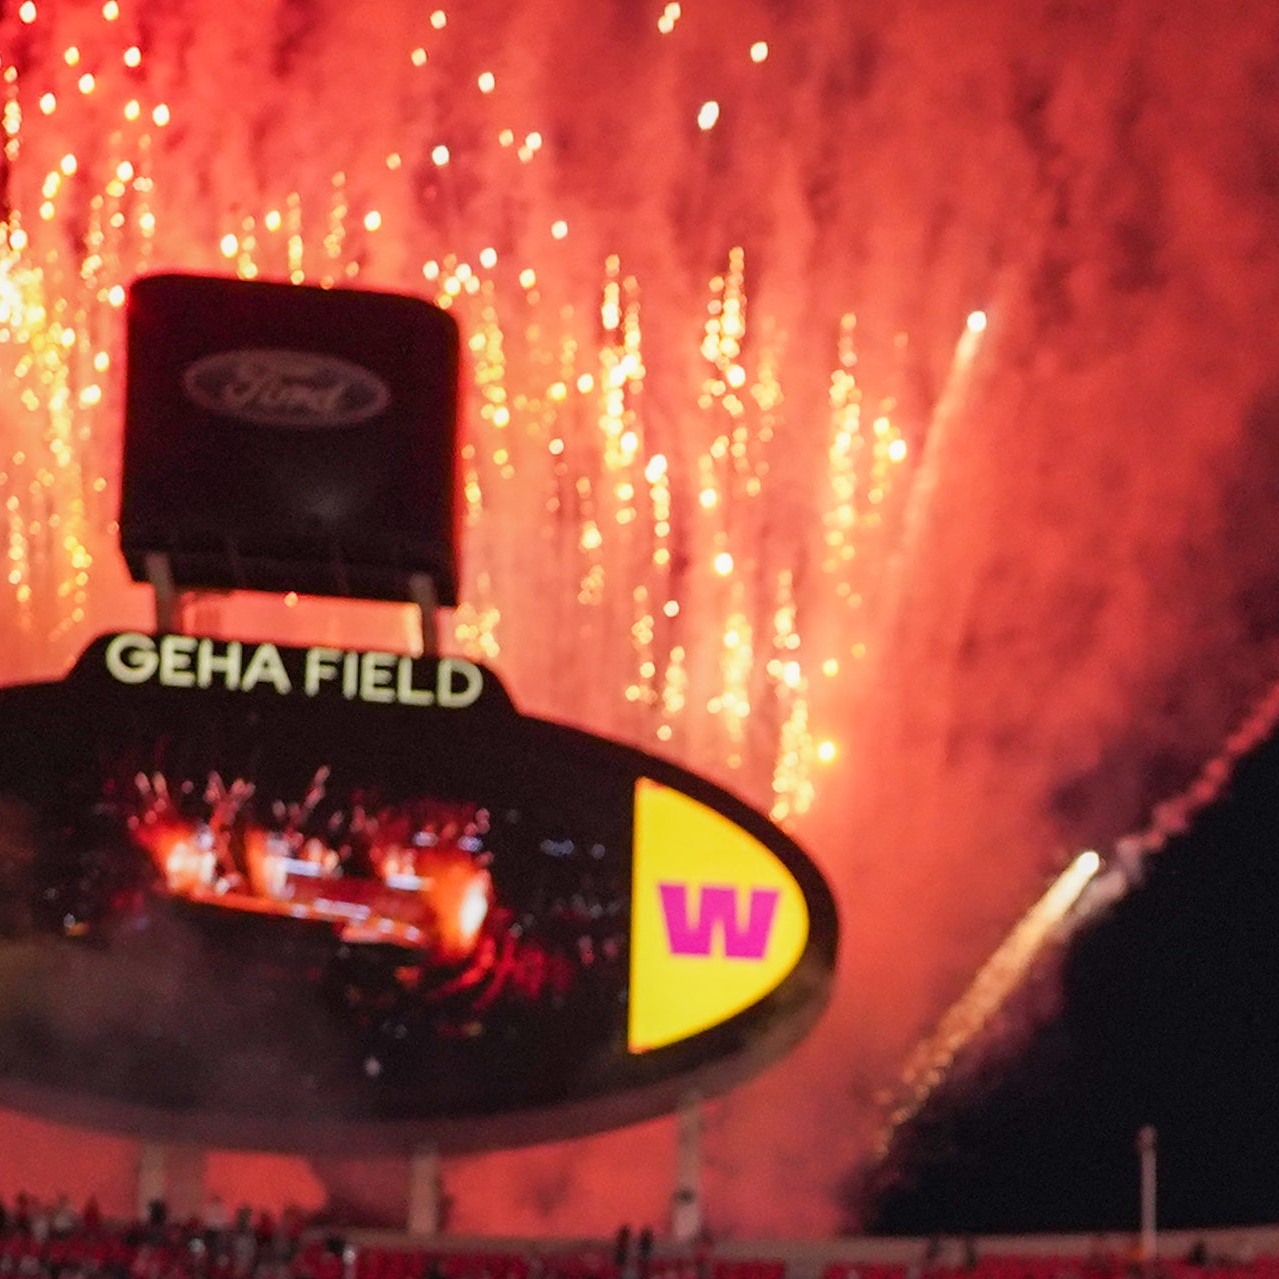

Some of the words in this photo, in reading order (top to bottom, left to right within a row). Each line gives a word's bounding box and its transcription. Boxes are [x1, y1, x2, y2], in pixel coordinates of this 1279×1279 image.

[105, 632, 292, 696] GEHA
[304, 646, 484, 709] FIELD
[657, 883, 780, 960] W
